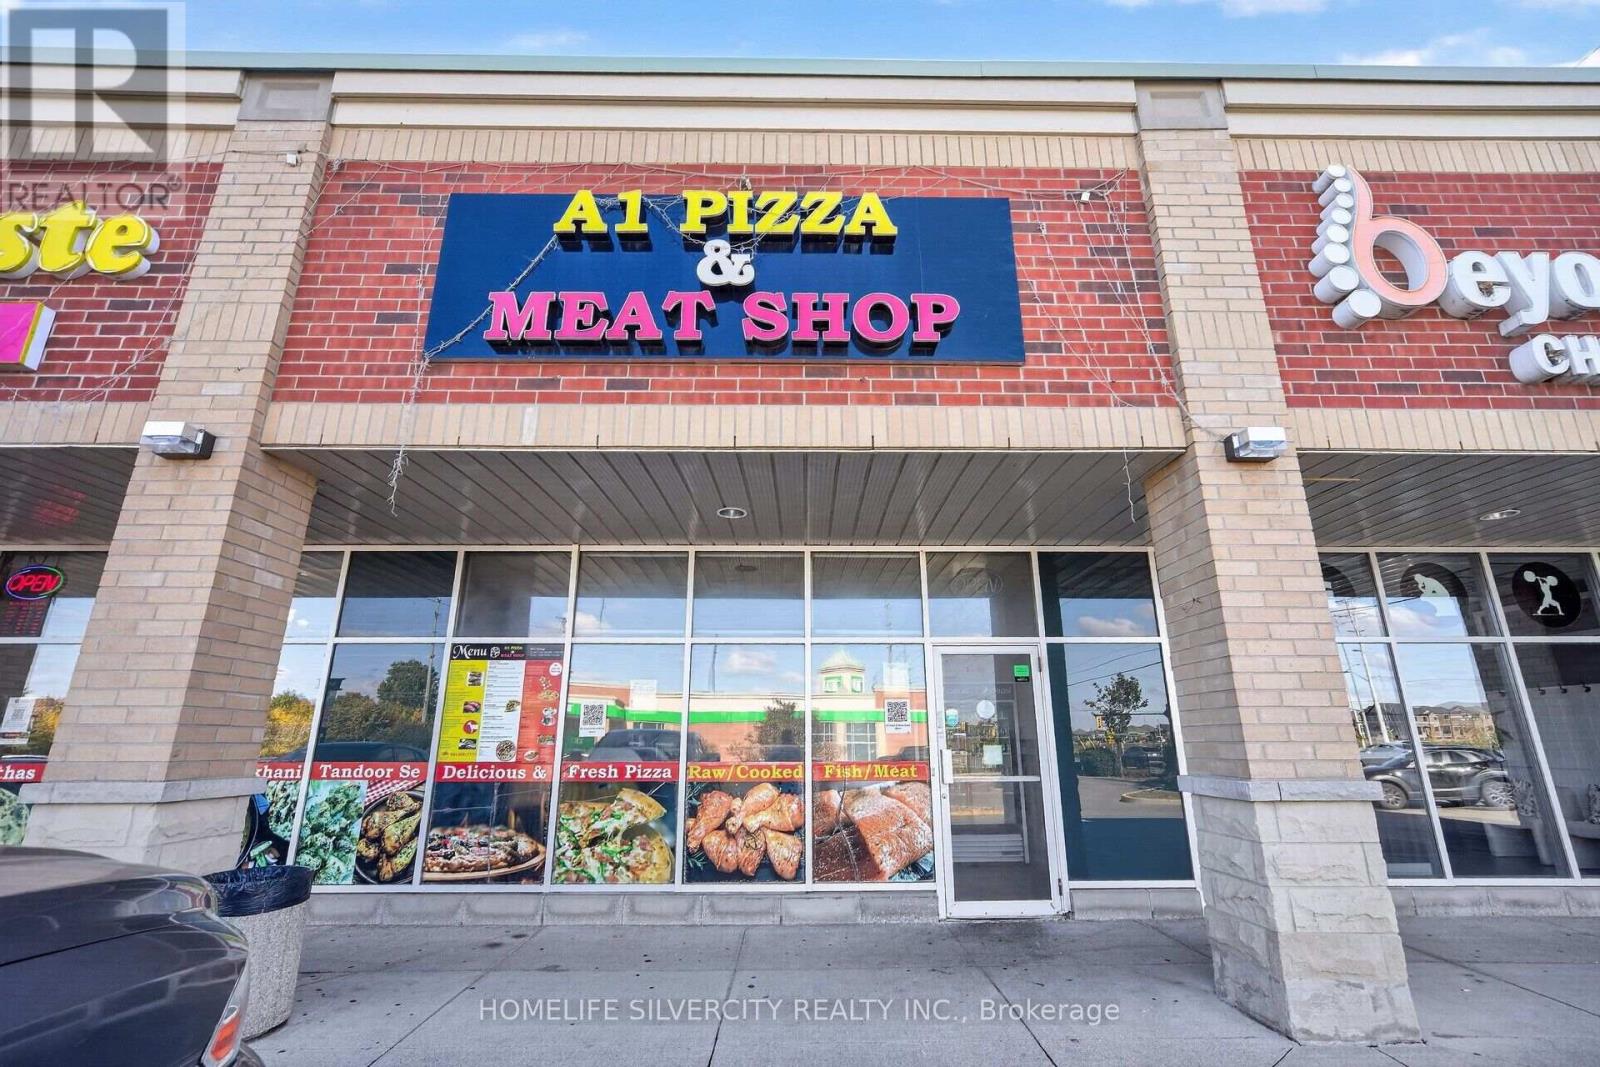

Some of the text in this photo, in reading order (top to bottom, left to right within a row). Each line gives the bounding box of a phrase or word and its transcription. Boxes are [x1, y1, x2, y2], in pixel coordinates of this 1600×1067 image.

[553, 189, 898, 236] A1 PIZZA
[696, 239, 755, 287] &
[483, 291, 961, 344] MEAT SHOP
[9, 574, 61, 592] OPEN
[453, 645, 487, 659] Menu
[320, 764, 420, 779] Tandoor Se
[442, 765, 547, 780] Delicious &
[567, 764, 672, 778] Fresh Pizza
[687, 764, 804, 781] Raw/Cooked
[824, 764, 918, 780] Fish/Meat
